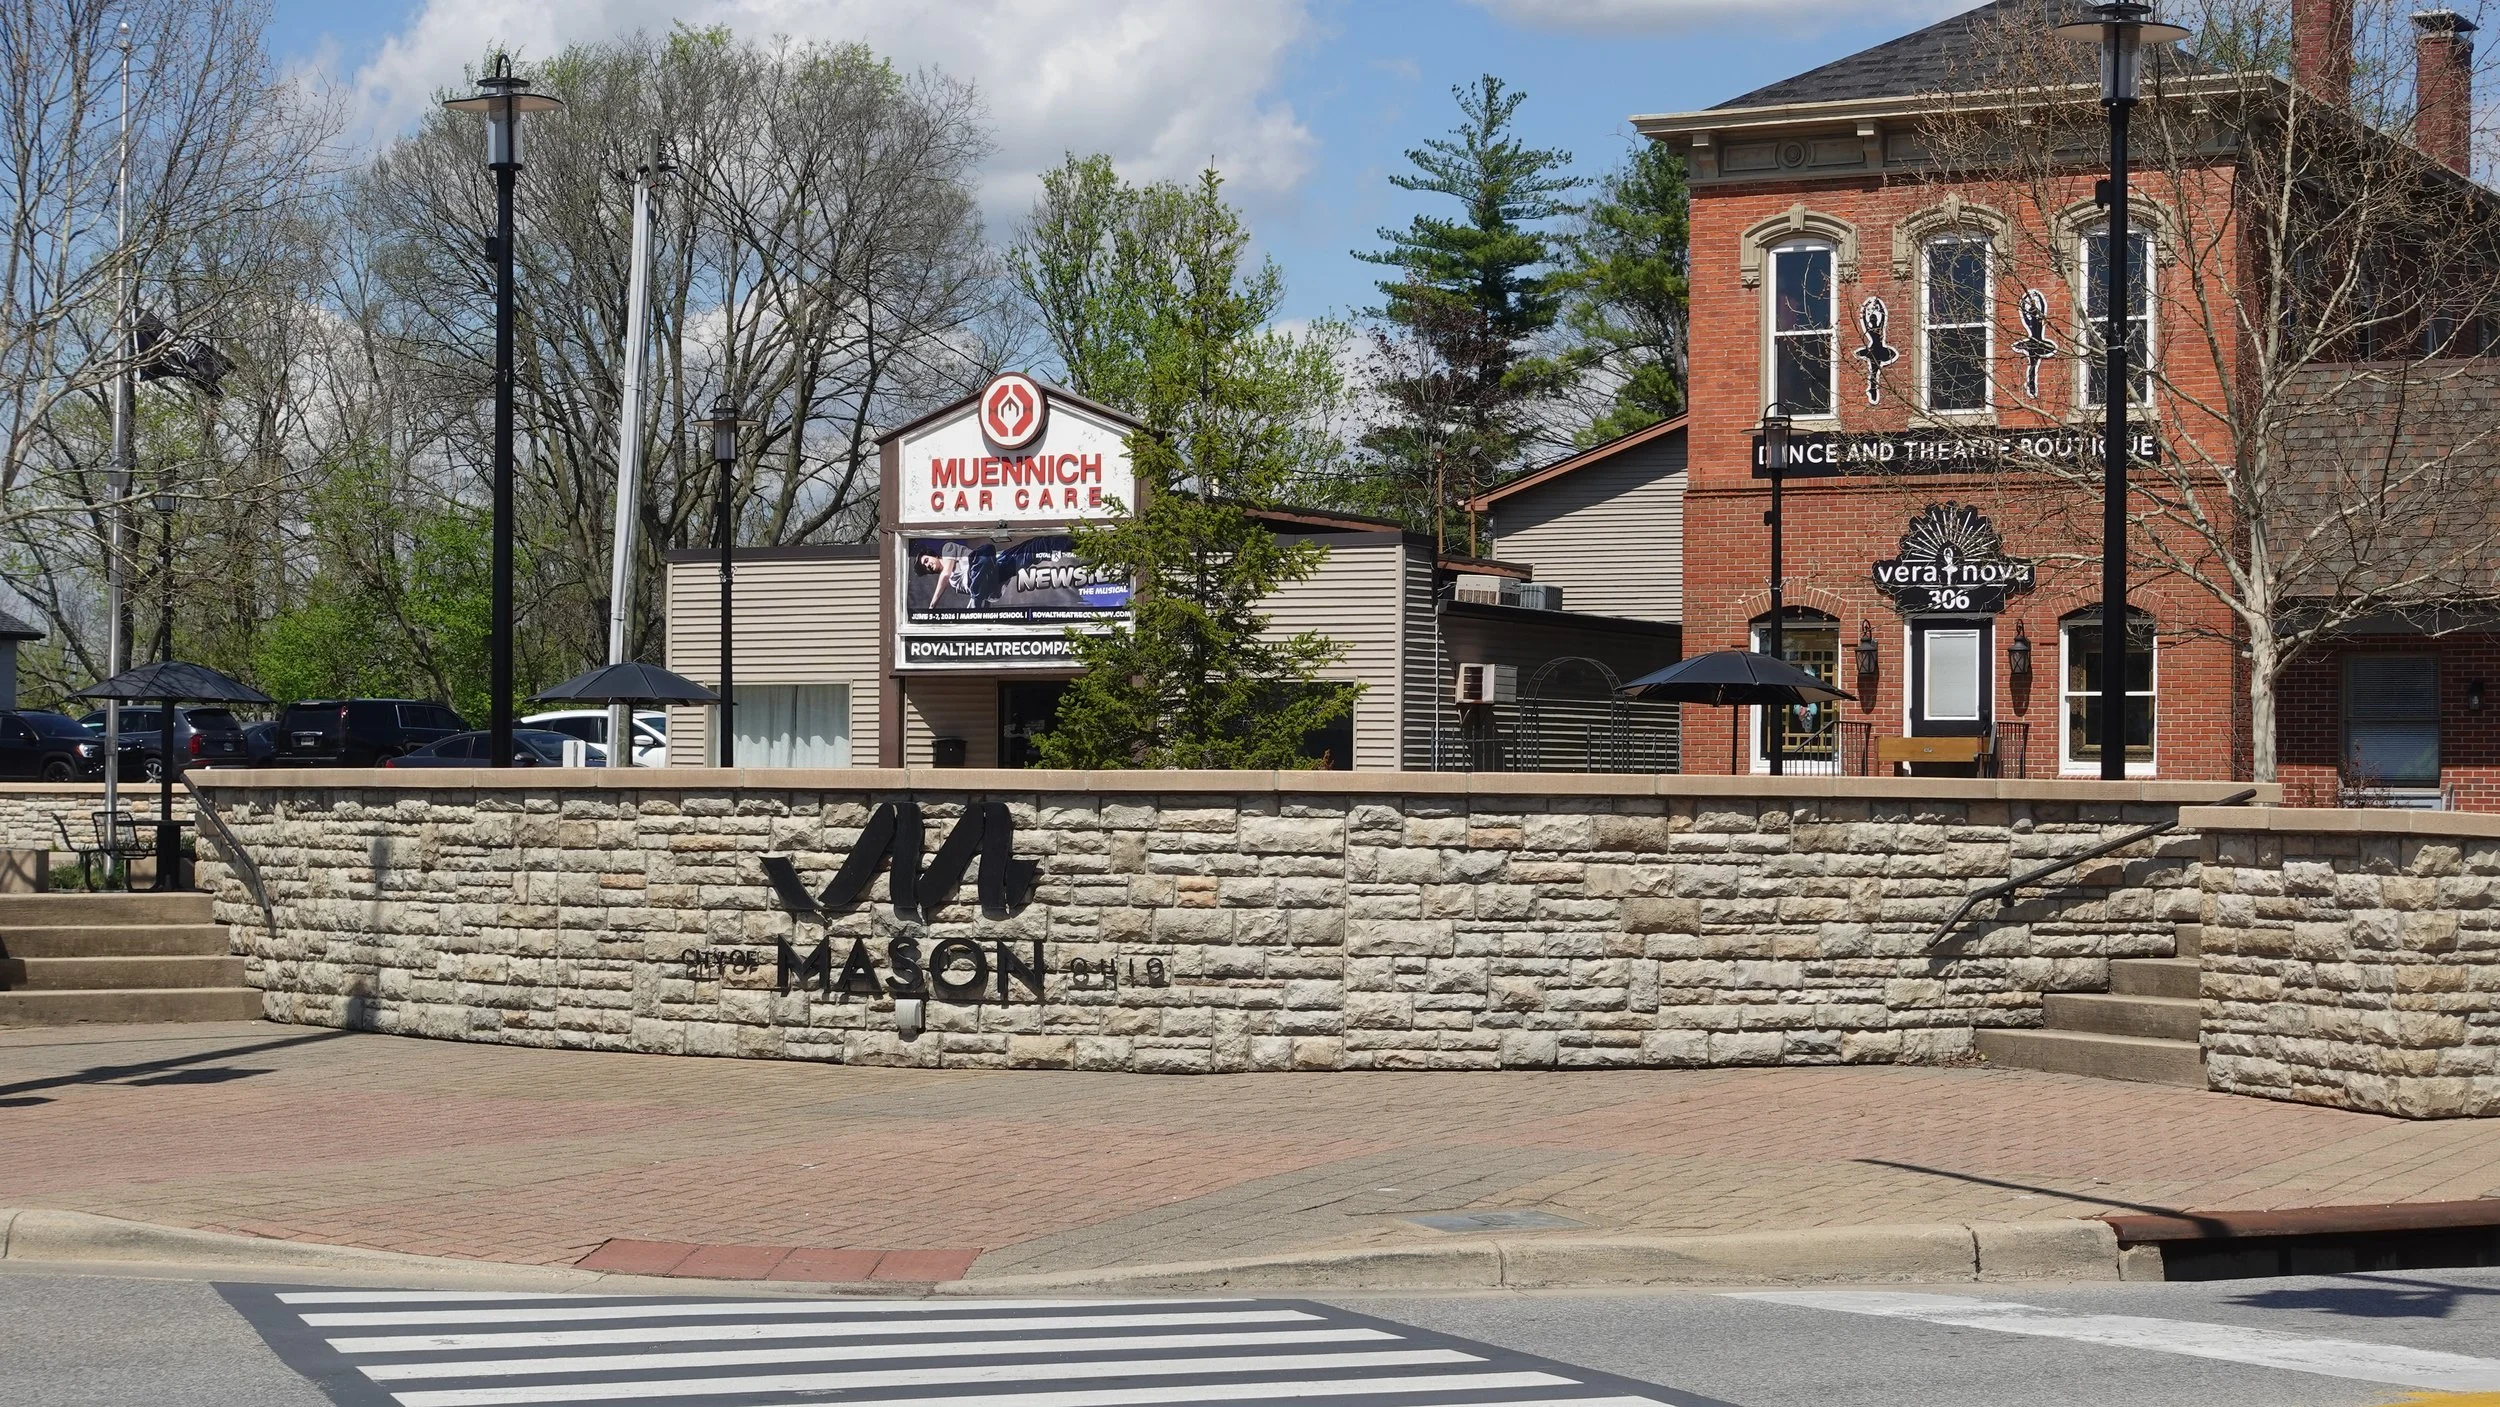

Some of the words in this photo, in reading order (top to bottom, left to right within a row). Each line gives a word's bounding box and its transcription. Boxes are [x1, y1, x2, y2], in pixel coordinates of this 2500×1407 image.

[1758, 443, 1838, 465] DNCE
[1846, 442, 1895, 463] AND
[2020, 435, 2154, 460] BOUTIUE
[931, 453, 1102, 489] MUENNICH
[930, 489, 993, 512] CAR
[1014, 486, 1103, 511] CARE
[1877, 565, 1937, 583] vera
[1962, 564, 2029, 582] nova
[1078, 588, 1094, 596] THE
[1095, 585, 1128, 595] MUSICAL
[1928, 589, 1970, 610] 306
[999, 611, 1024, 619] SCHOOL
[681, 949, 725, 968] CITY
[777, 934, 1045, 994] MASON
[1071, 957, 1163, 975] OHIO
